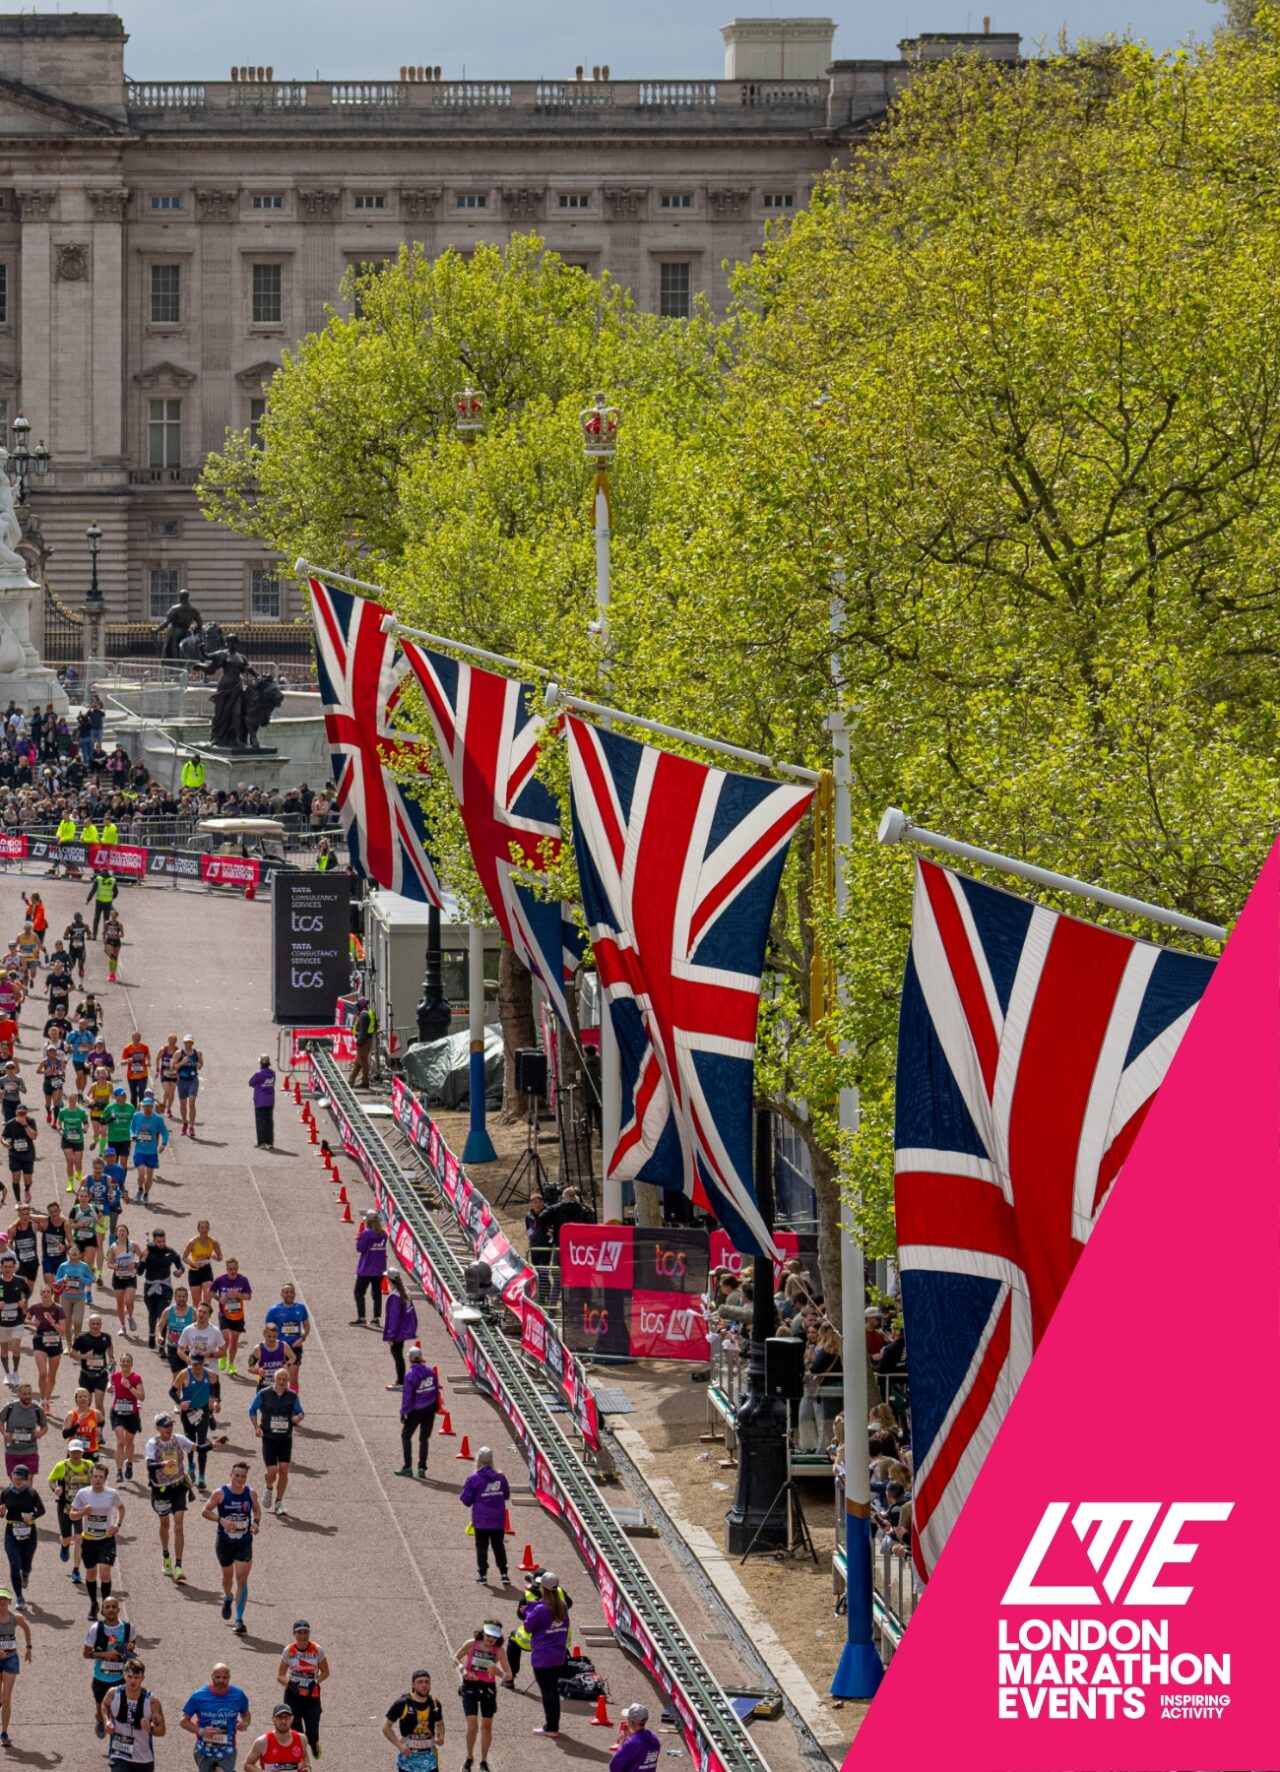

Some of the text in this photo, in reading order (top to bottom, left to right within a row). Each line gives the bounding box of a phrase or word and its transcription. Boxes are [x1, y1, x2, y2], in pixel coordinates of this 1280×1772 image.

[48, 851, 85, 862] MARATHON
[59, 846, 85, 856] LONDON
[166, 863, 198, 875] MARATHON
[175, 858, 198, 868] LONDON
[291, 911, 324, 932] tcs
[291, 967, 324, 988] tcs
[569, 1241, 595, 1265] tcs
[655, 1243, 687, 1276] tcs
[583, 1303, 609, 1334] tcs
[640, 1307, 665, 1333] tcs
